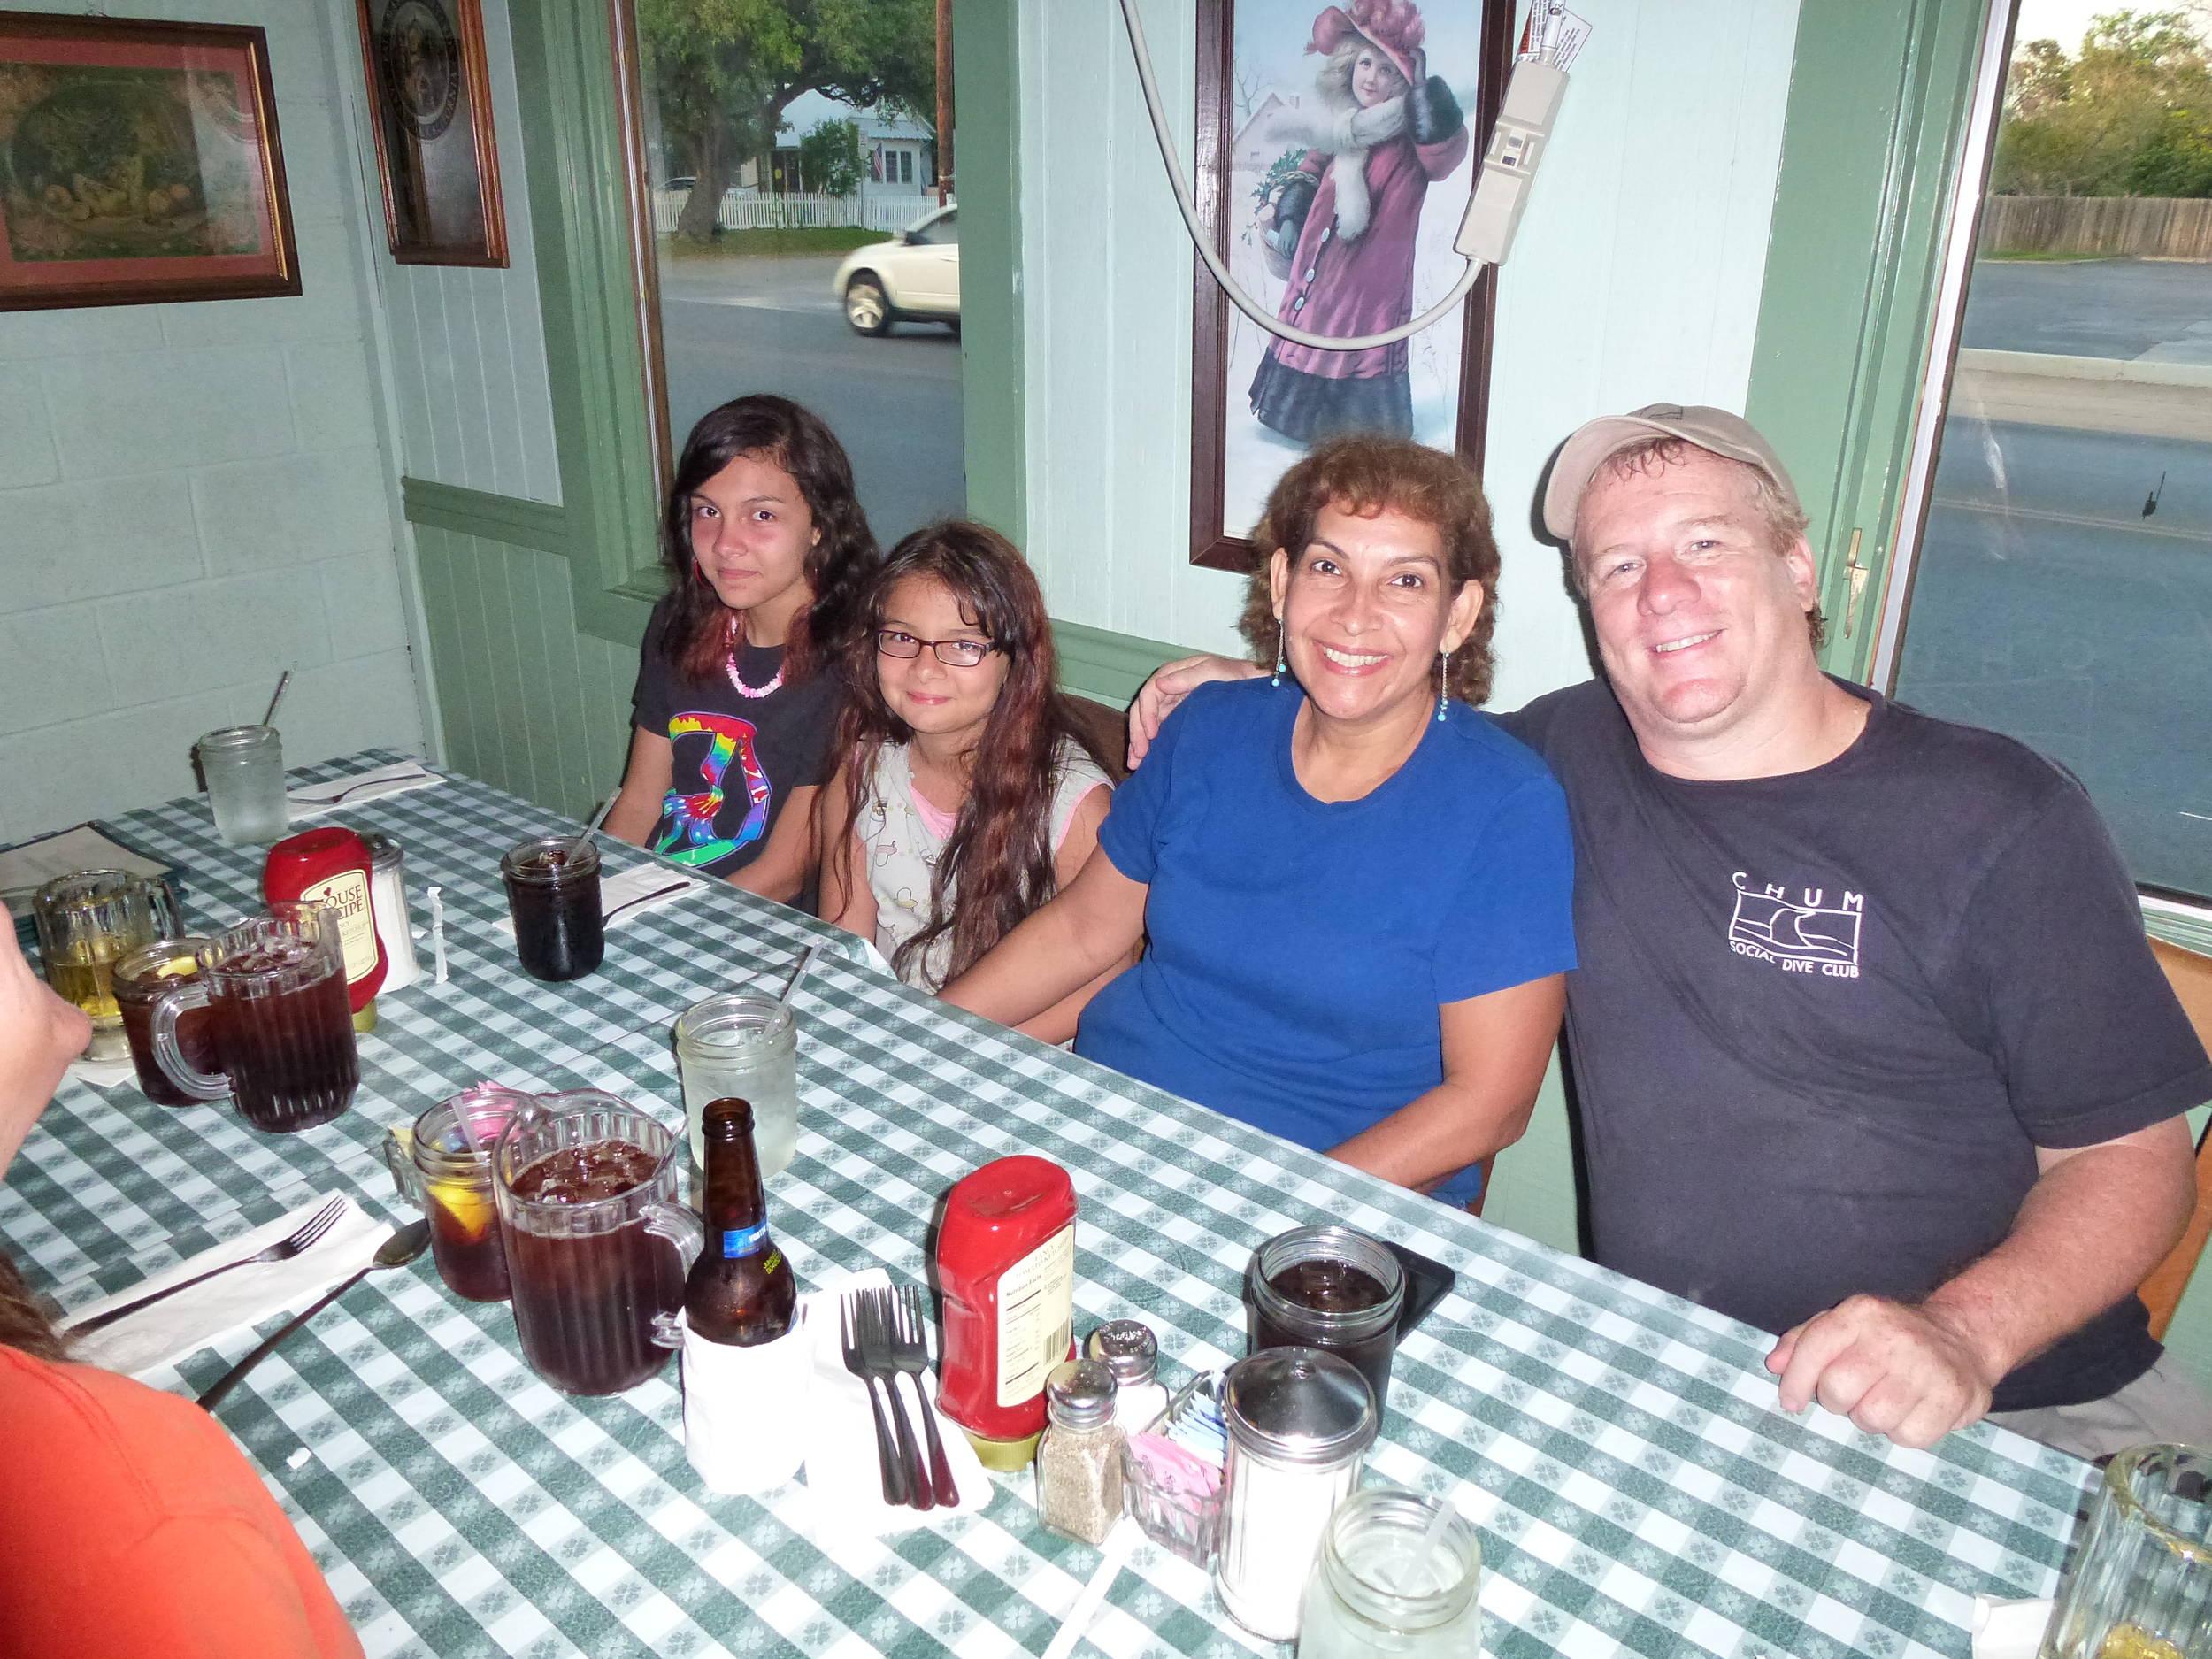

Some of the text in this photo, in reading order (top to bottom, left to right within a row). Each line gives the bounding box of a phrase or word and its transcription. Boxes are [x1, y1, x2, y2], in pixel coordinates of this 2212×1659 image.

[326, 885, 363, 909] OUSE
[1732, 871, 1863, 911] CHUM
[335, 898, 363, 920] CIPE
[1729, 941, 1860, 979] SOCIAL DIVE CLUB
